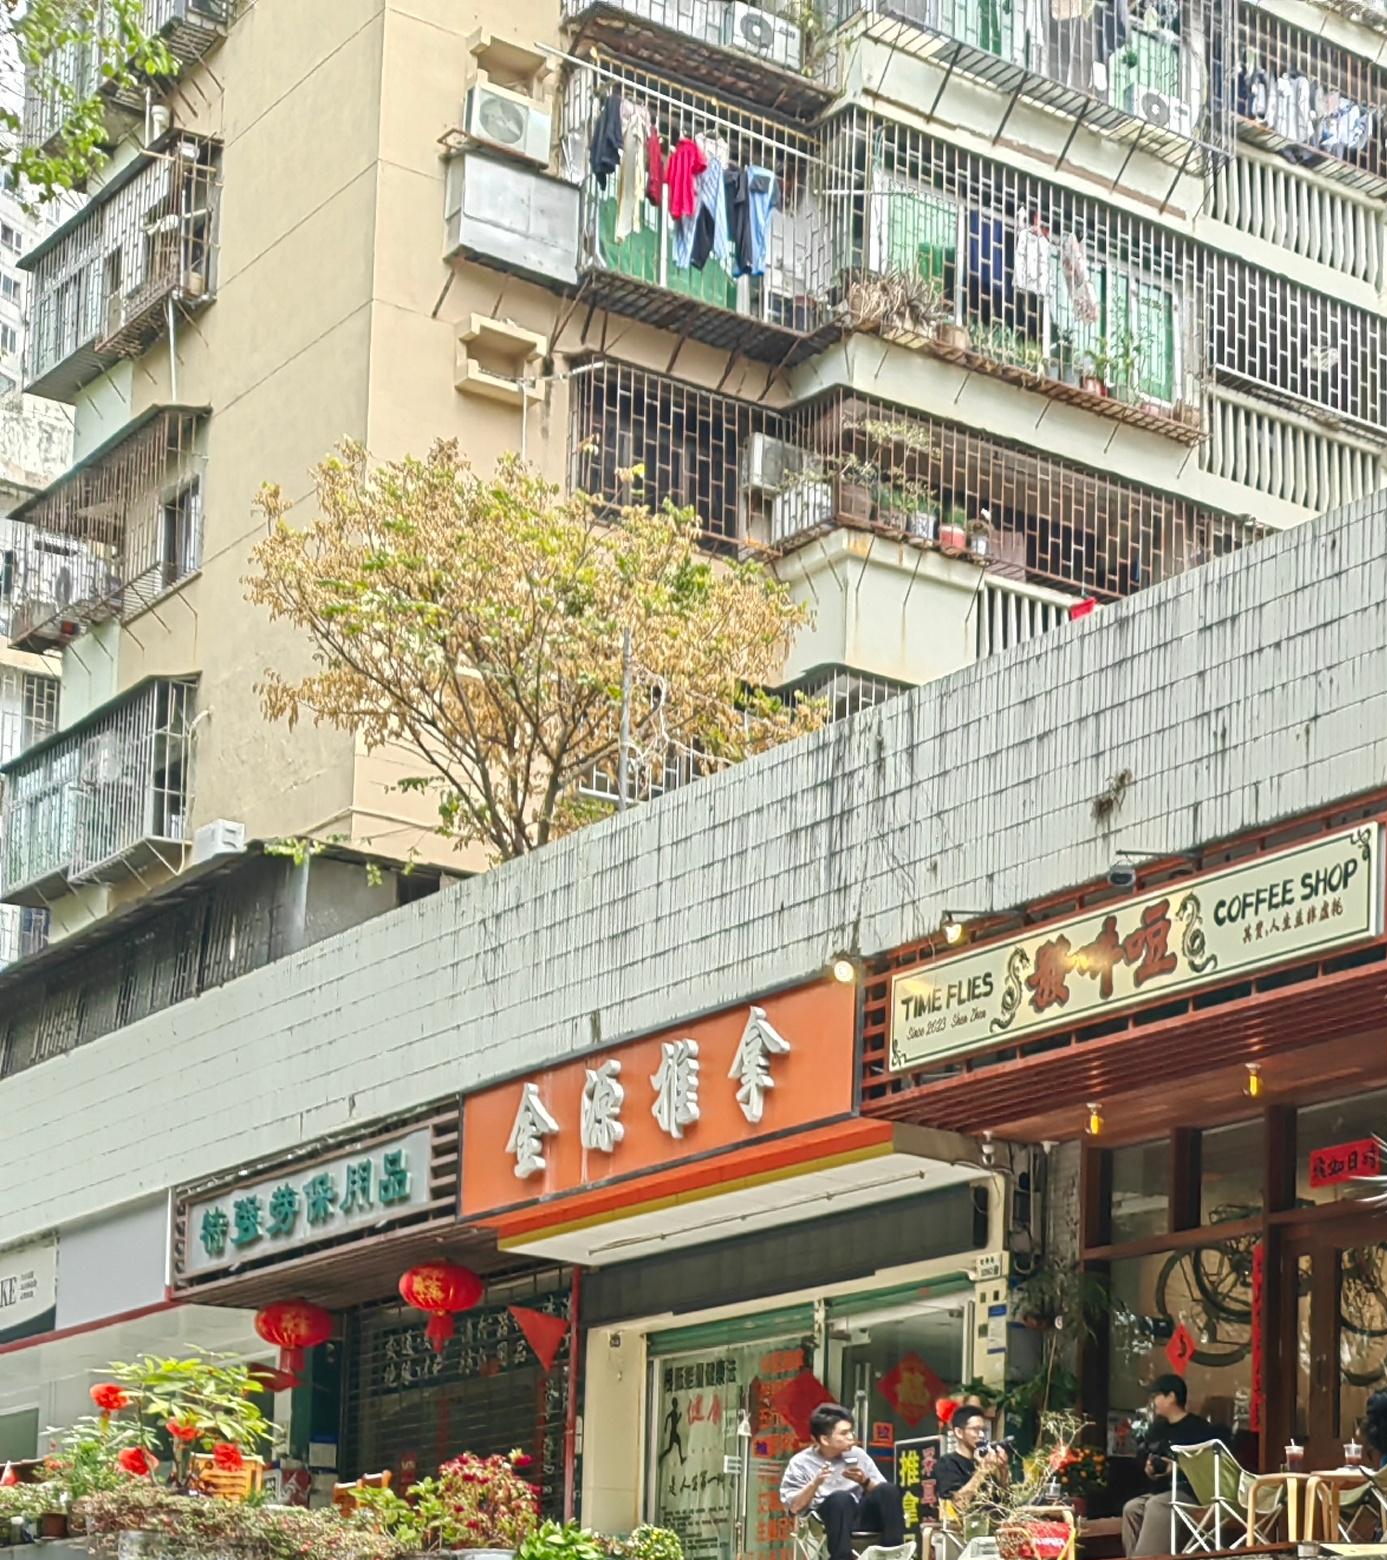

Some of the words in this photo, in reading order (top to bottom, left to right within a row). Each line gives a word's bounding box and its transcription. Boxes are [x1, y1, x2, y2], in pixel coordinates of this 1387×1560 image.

[1214, 879, 1295, 926] COFFEE
[1301, 858, 1357, 901] SHOP
[901, 988, 942, 1021] TIME
[946, 972, 993, 1010] FLIES
[506, 1005, 790, 1178] 金源推拿
[899, 1450, 921, 1542] 推拿
